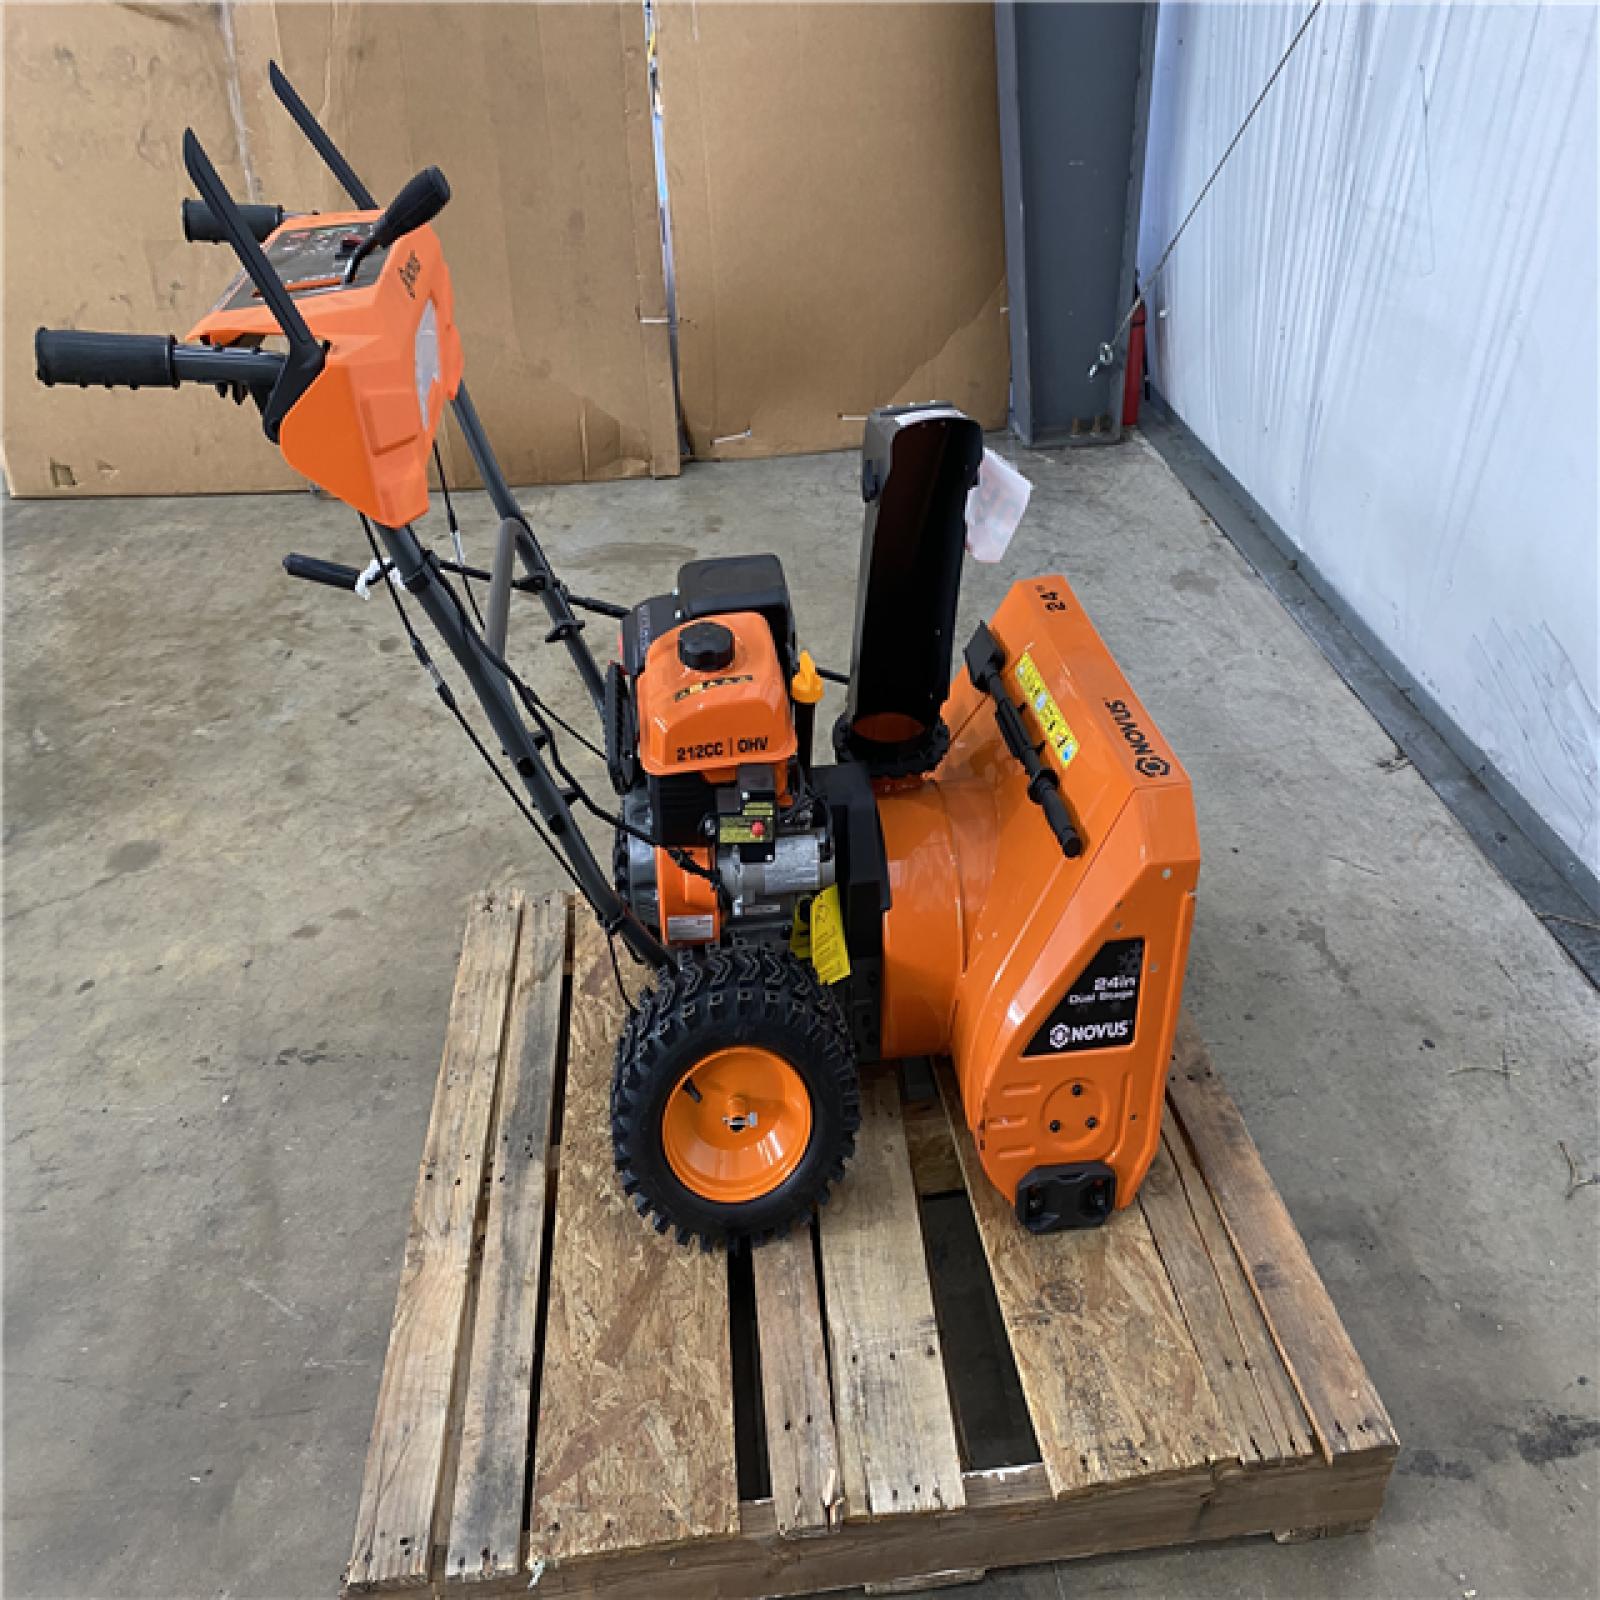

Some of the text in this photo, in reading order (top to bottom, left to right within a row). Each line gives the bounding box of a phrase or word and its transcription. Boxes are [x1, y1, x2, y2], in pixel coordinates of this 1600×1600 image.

[1106, 699, 1153, 756] NOVUS
[676, 736, 769, 761] 212CC OHV
[1071, 1021, 1128, 1042] NOVUS
